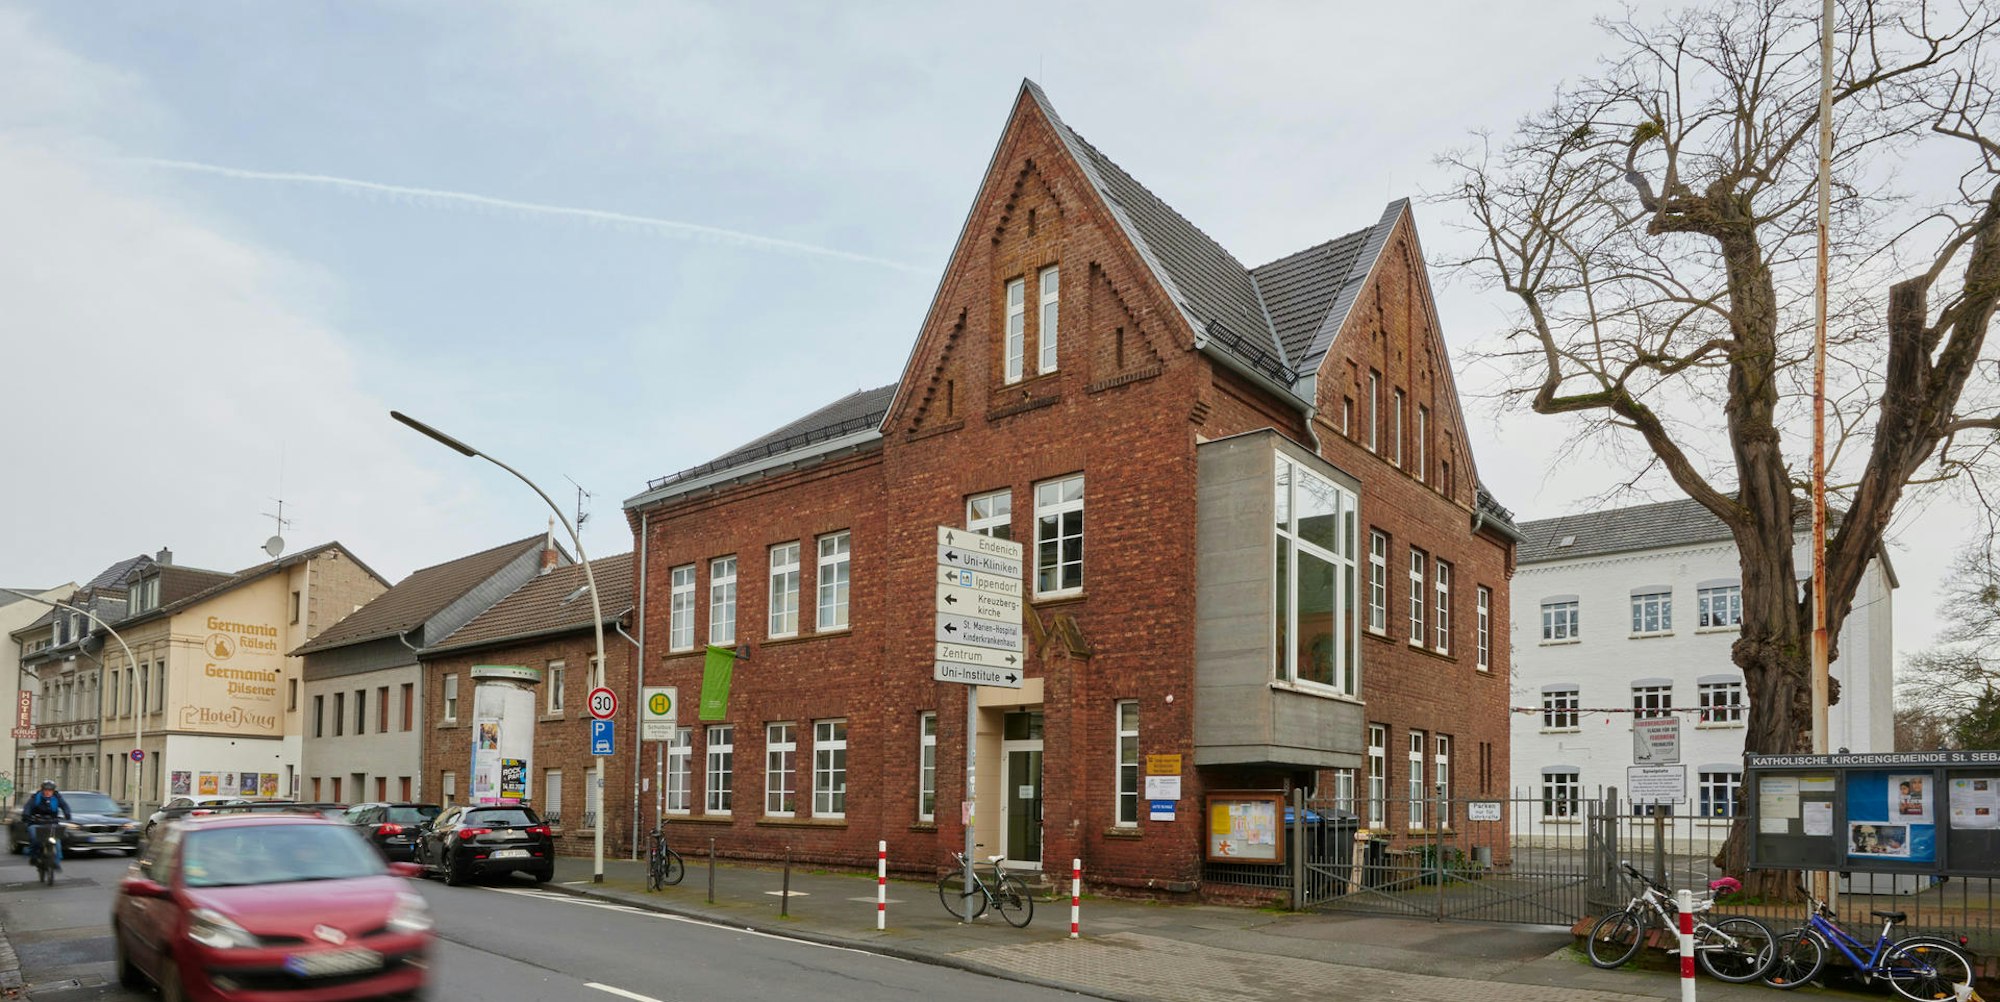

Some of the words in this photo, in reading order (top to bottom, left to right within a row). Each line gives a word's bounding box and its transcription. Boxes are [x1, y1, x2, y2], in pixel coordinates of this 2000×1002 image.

[978, 539, 1018, 557] Endenich
[963, 554, 1018, 574] Uni-Kliniken
[975, 575, 1018, 593] Ippendorf
[978, 594, 1020, 611] Kreuzberg-
[977, 605, 1001, 618] kirche
[207, 616, 278, 637] Germania
[963, 620, 971, 630] St.
[973, 621, 1018, 636] Marien-Hospital
[239, 635, 277, 651] Kölsch
[962, 632, 1017, 648] Kinderkrankenhaus
[942, 646, 983, 661] Zentrum
[205, 663, 276, 682] Germania
[941, 665, 1001, 682] Uni-Institute
[227, 681, 277, 695] Pilsener
[21, 692, 30, 726] HOTEL
[594, 696, 611, 711] 30
[655, 697, 665, 711] H
[200, 707, 237, 723] Hotel
[230, 706, 276, 729] Krug
[595, 722, 606, 736] P
[1752, 756, 1828, 766] KATHOLISCHE
[1831, 753, 1947, 764] KIRCHENGEMEINDE
[1951, 753, 1968, 762] St.
[1971, 752, 2000, 761] SEB
